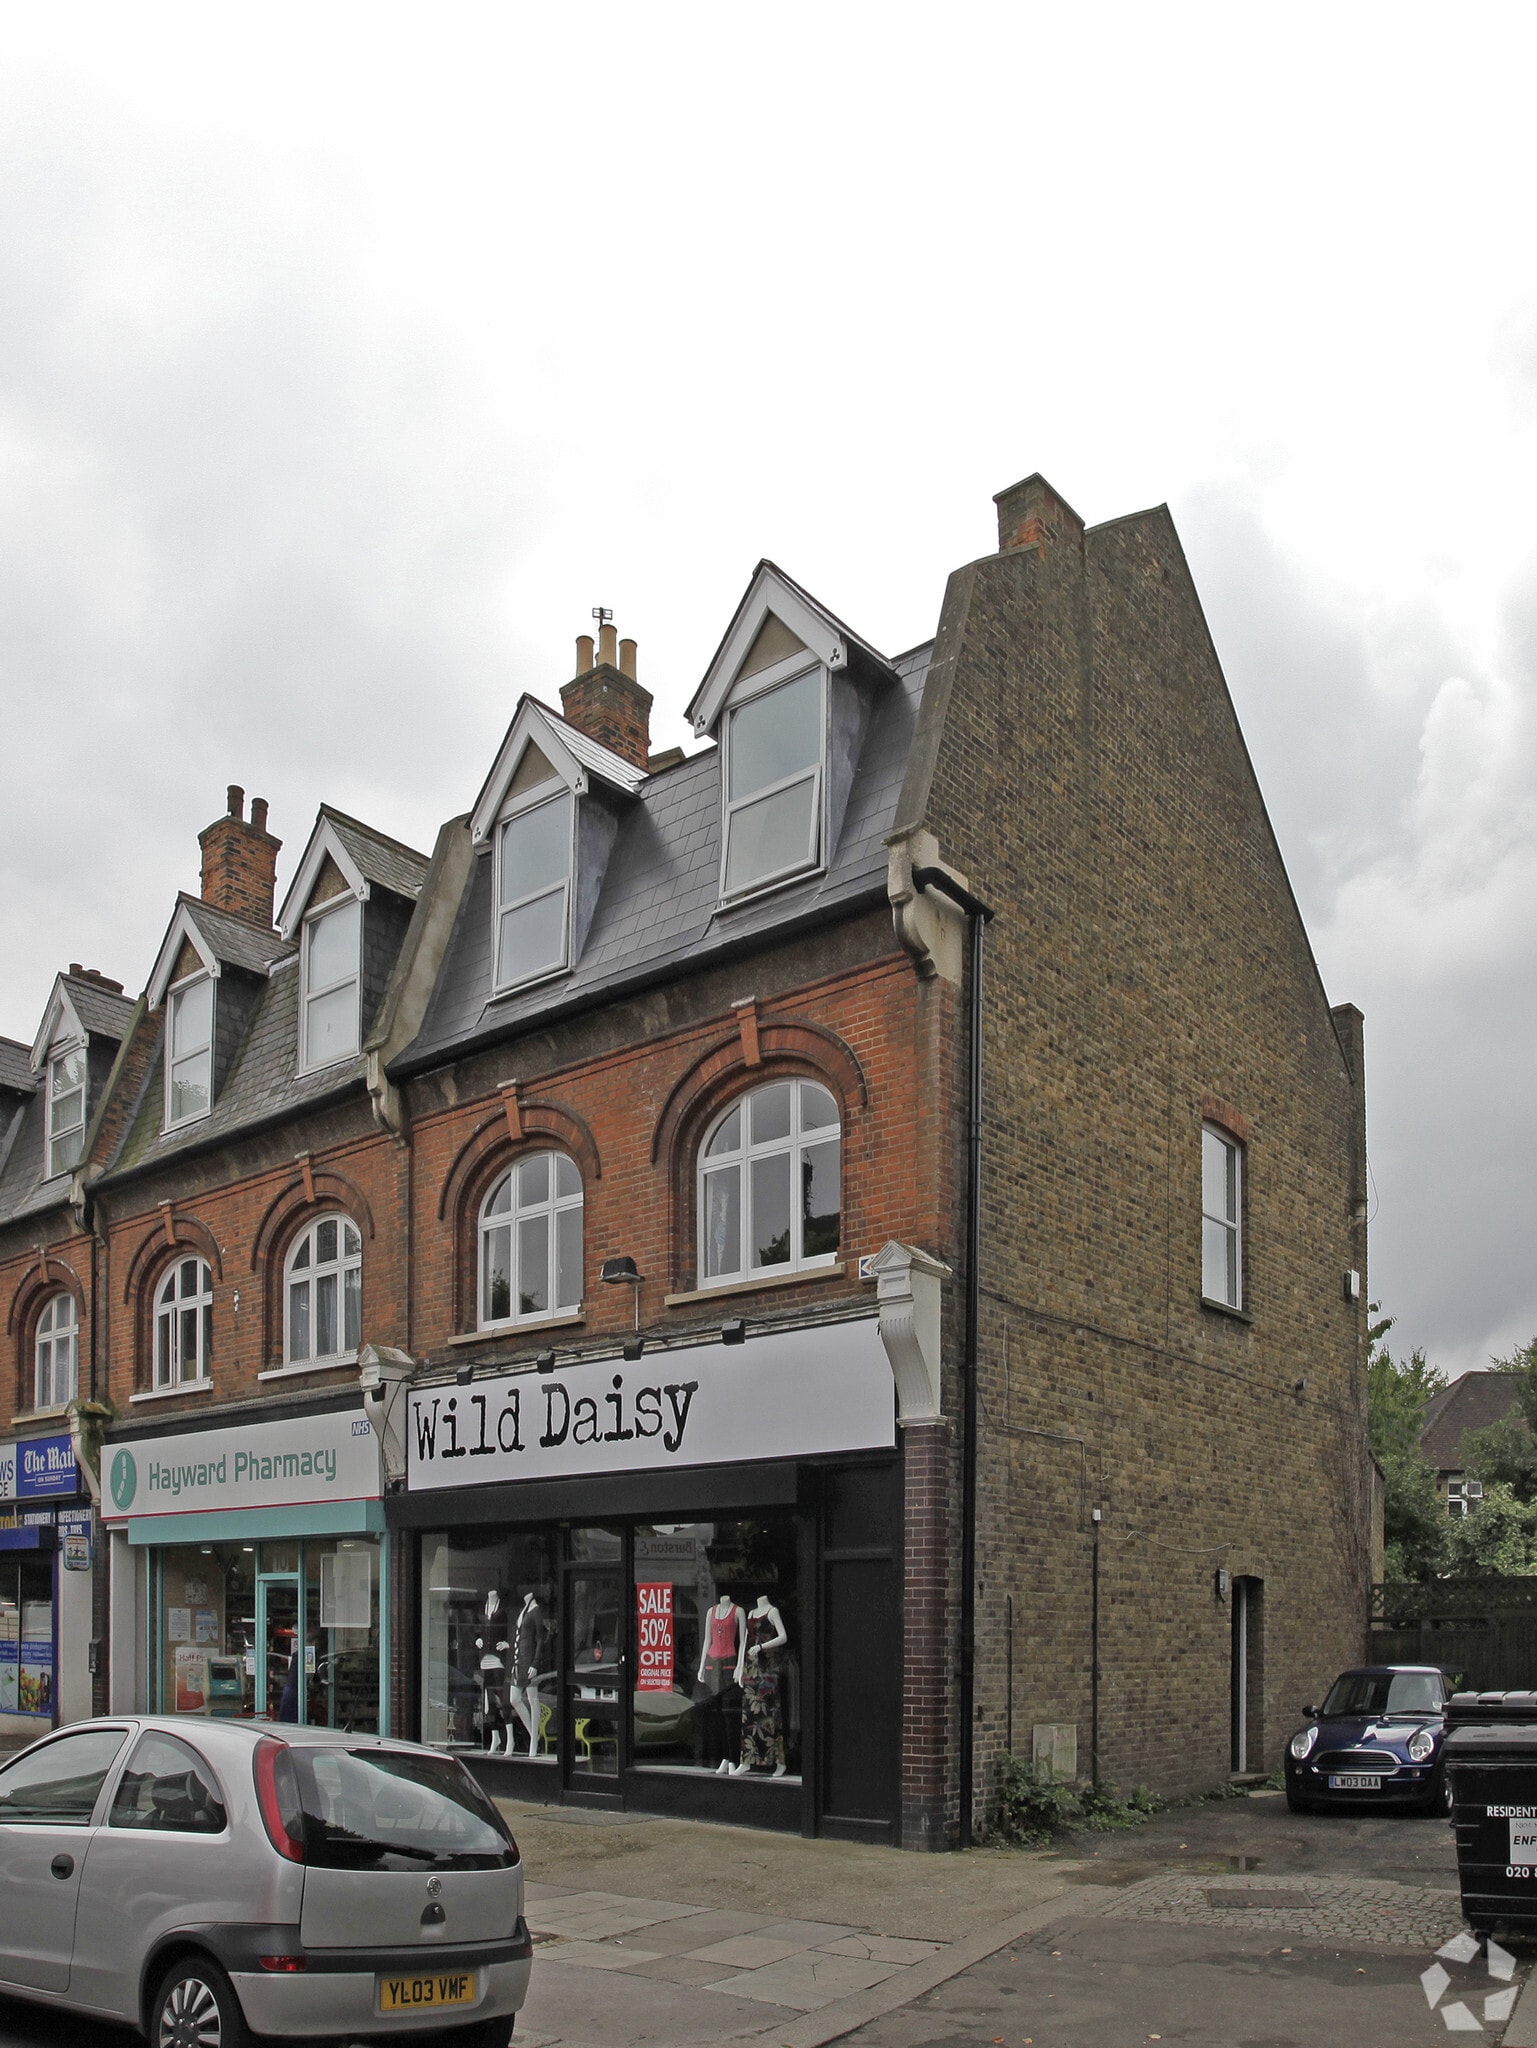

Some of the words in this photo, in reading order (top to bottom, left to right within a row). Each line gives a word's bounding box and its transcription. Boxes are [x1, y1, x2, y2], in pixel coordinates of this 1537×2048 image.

[413, 1388, 525, 1461] Wild
[539, 1374, 699, 1452] Daisy
[352, 1421, 370, 1436] NHS
[24, 1450, 45, 1474] The
[149, 1454, 227, 1495] Hayward
[234, 1449, 337, 1482] Pharmacy
[639, 1588, 671, 1614] SALE
[640, 1618, 671, 1647] 50%
[640, 1650, 671, 1666] OFF
[640, 1668, 660, 1677] ORIGINAL
[660, 1668, 671, 1677] PRICE
[1334, 1777, 1359, 1787] LW03
[1486, 1805, 1537, 1818] RESIDENT
[1505, 1866, 1530, 1878] 020
[389, 1980, 434, 2004] YL03
[439, 1976, 468, 2000] VMF
